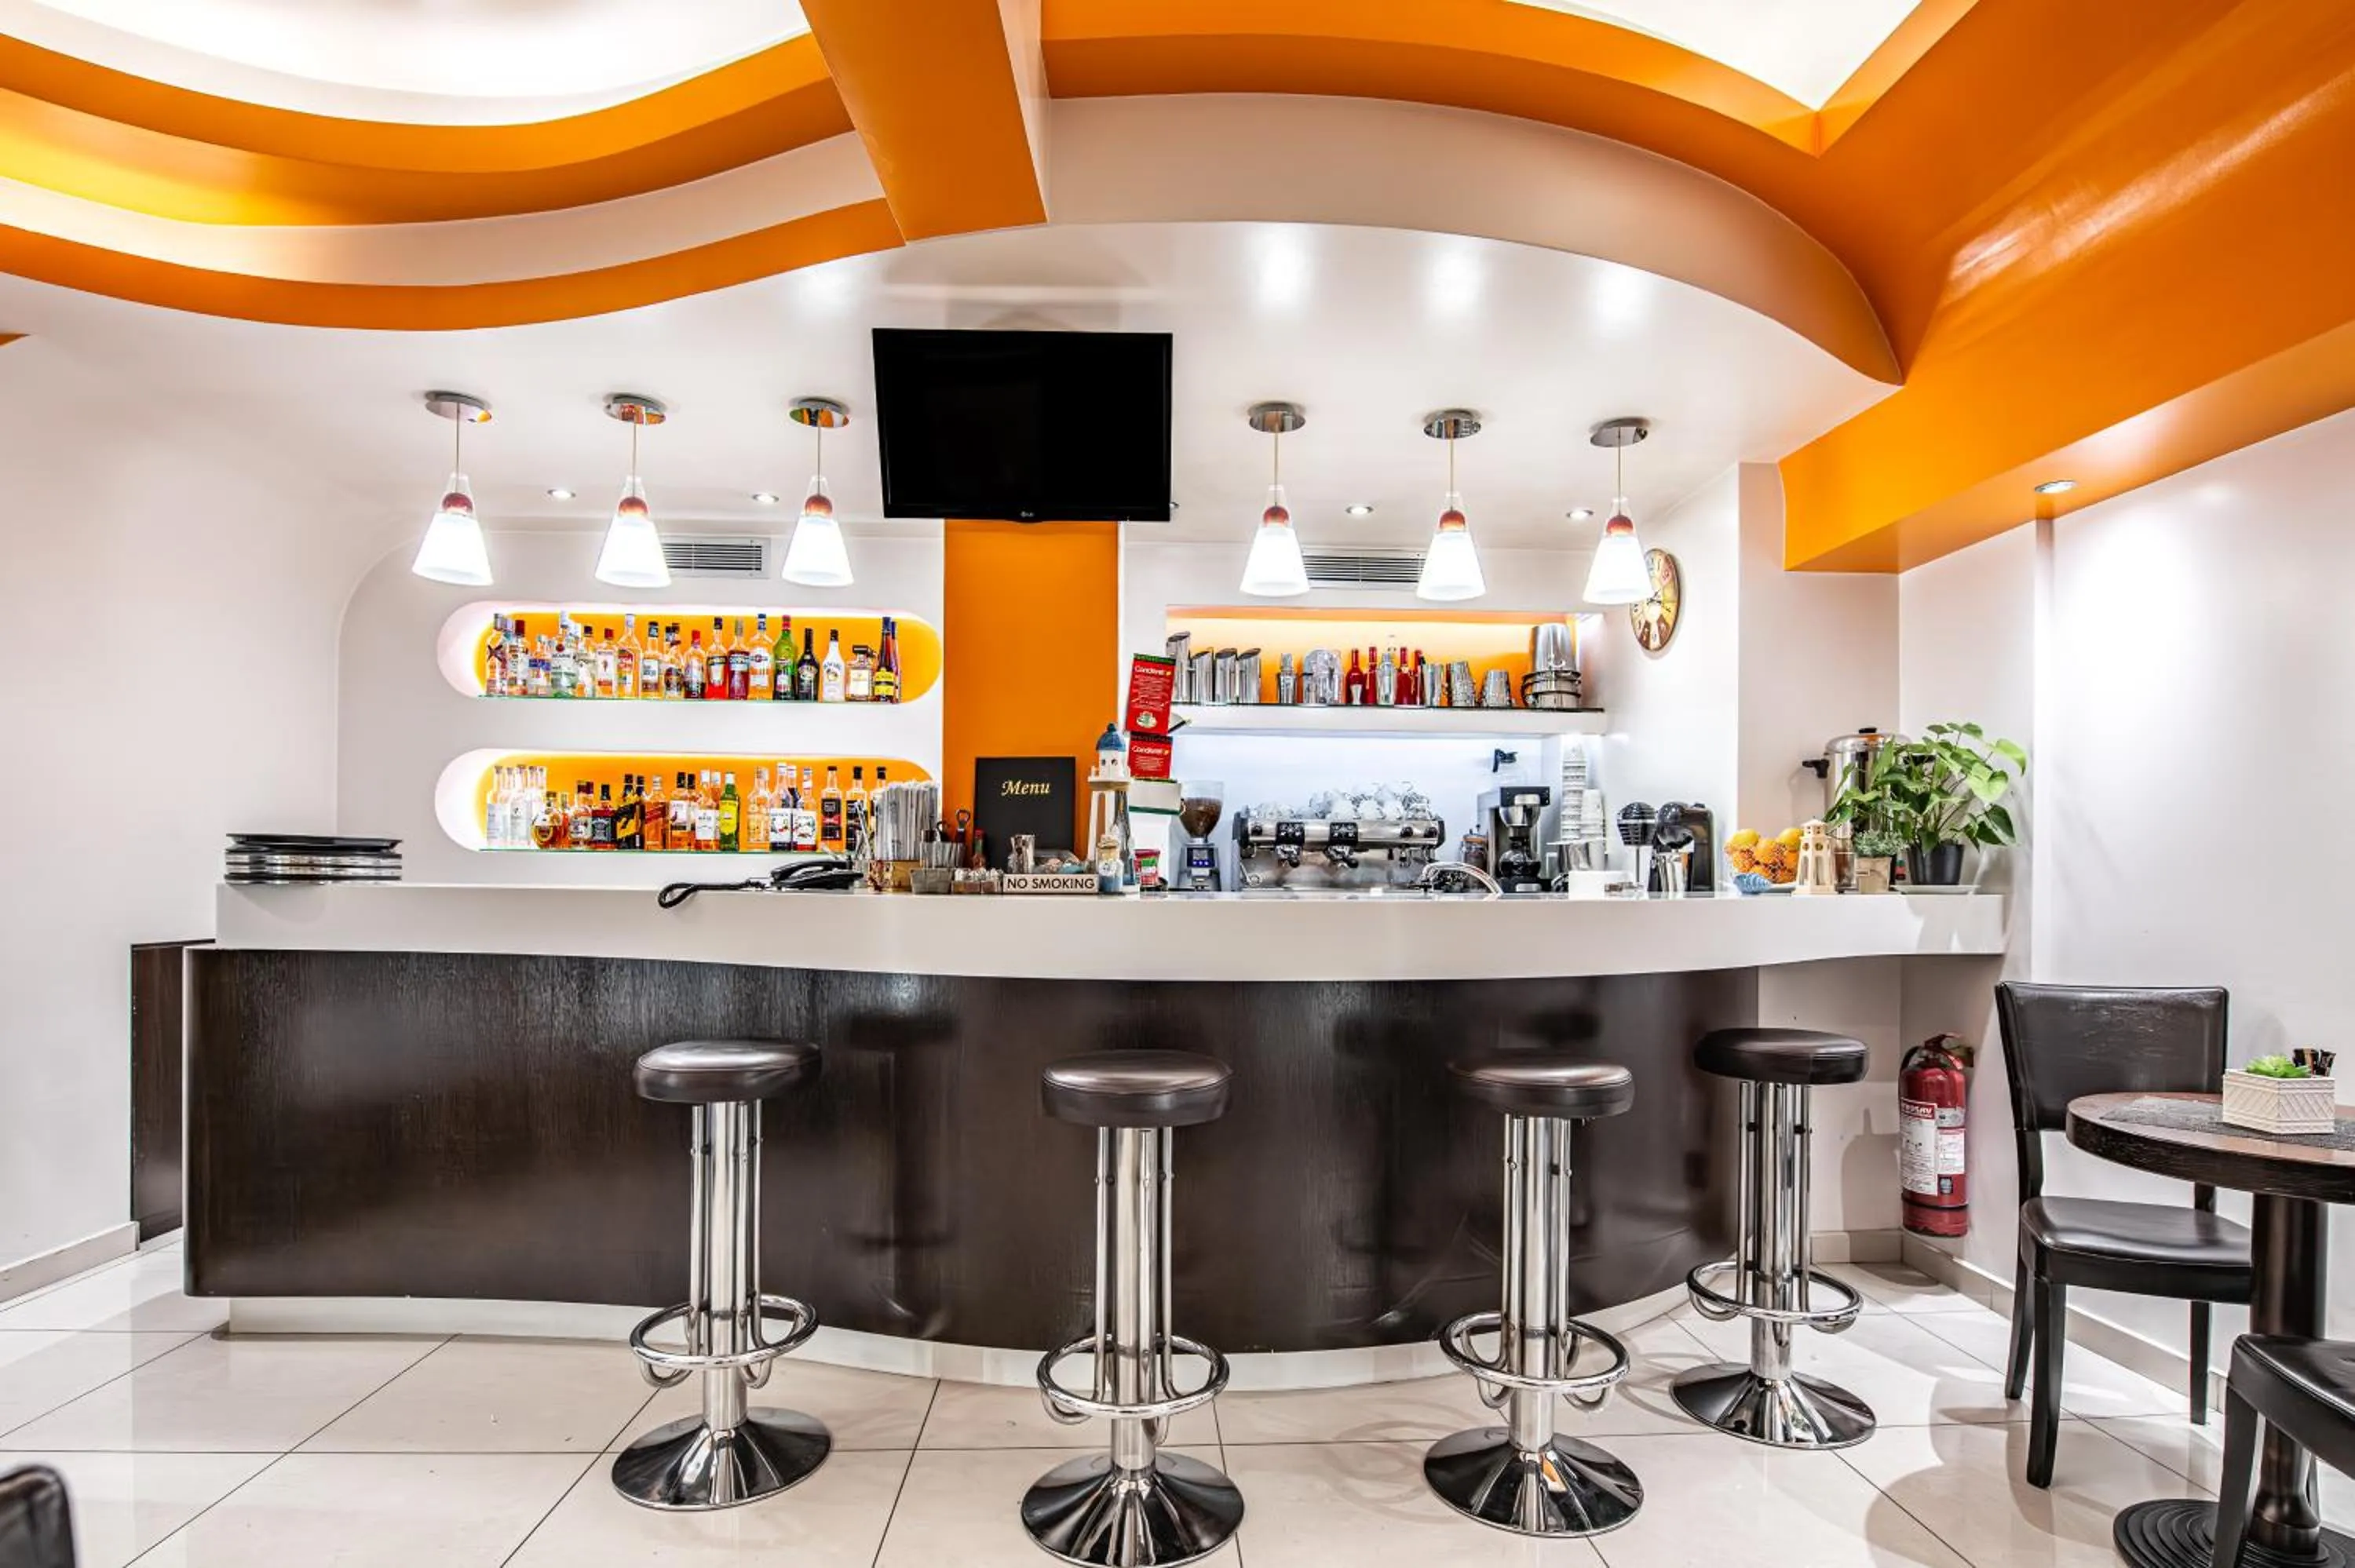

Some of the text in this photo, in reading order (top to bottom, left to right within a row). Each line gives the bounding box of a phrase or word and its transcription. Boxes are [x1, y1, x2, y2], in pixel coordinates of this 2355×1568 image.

[1001, 780, 1050, 797] Menu
[1007, 878, 1095, 889] NO SMOKING
